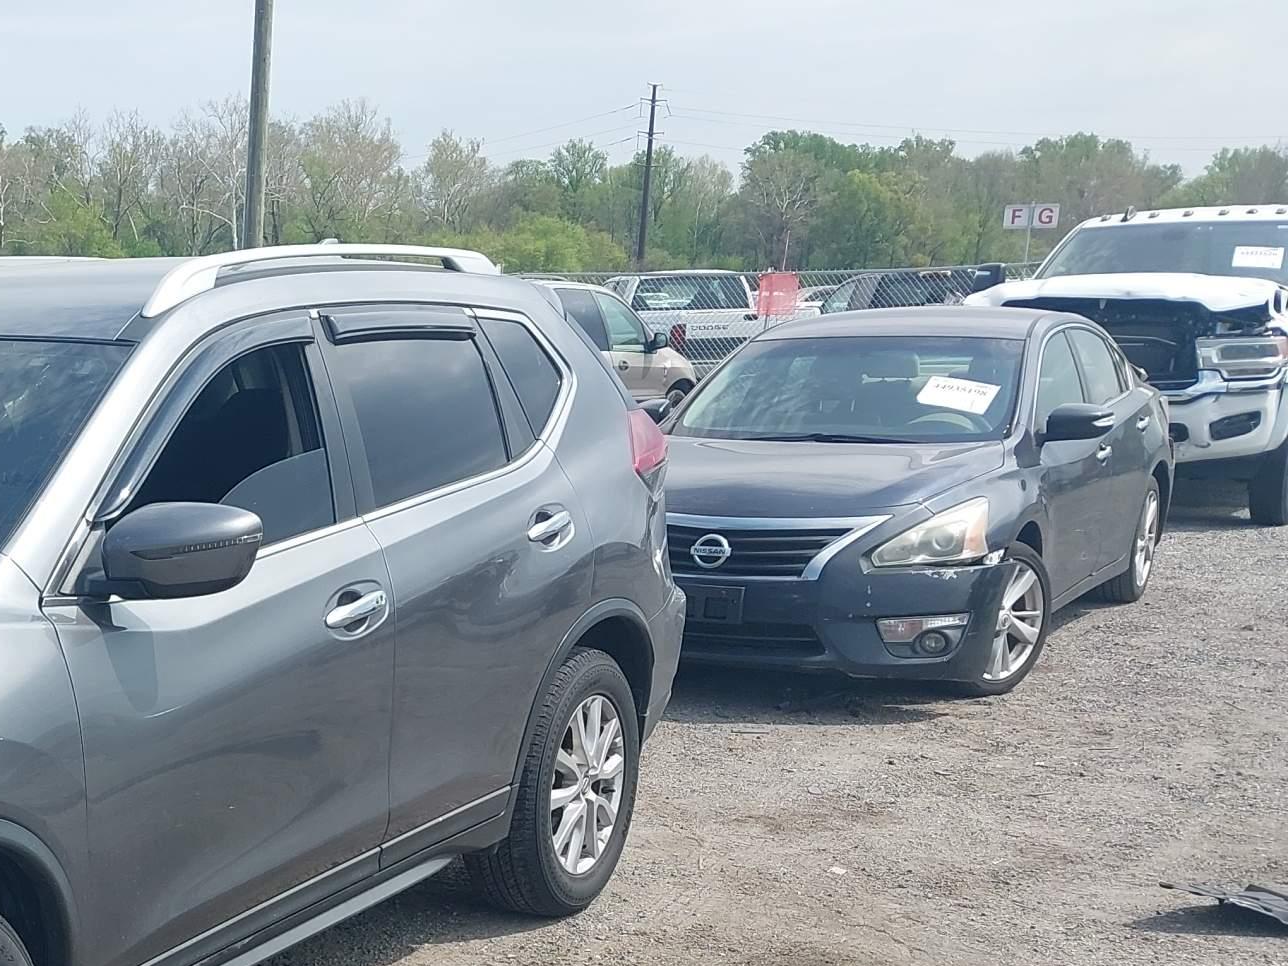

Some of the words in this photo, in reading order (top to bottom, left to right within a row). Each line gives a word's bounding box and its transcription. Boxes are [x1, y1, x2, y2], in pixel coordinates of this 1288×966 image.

[1011, 208, 1023, 225] F
[1038, 207, 1054, 225] G
[693, 547, 727, 555] NISSAN
